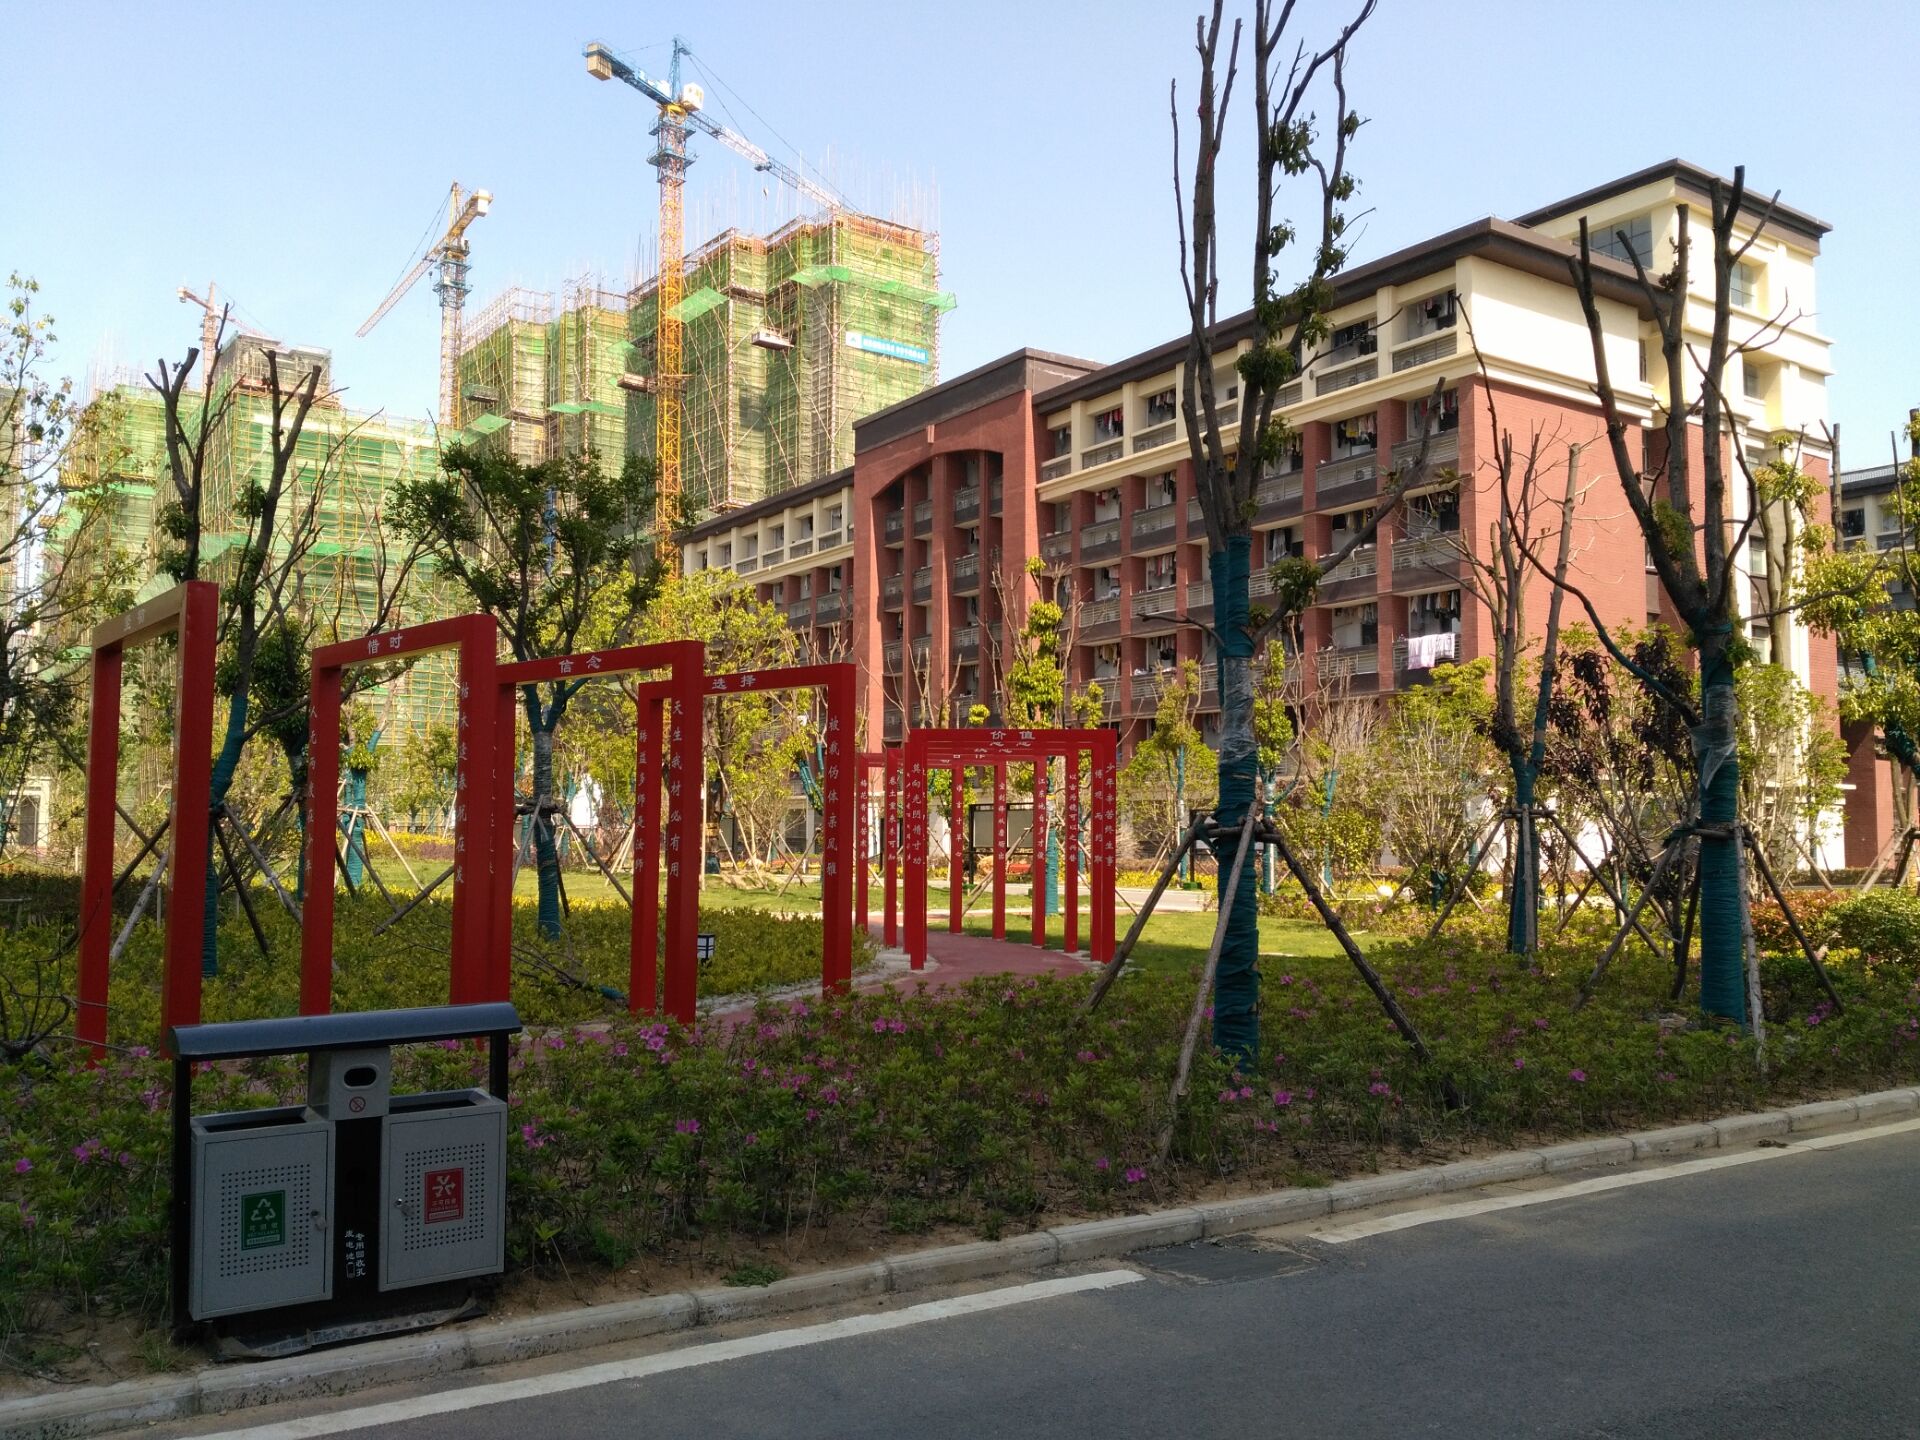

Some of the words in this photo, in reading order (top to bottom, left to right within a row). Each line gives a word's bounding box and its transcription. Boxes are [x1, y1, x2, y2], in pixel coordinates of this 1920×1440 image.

[367, 633, 403, 655] 惜时
[558, 654, 602, 674] 信念
[711, 674, 757, 691] 选择
[990, 730, 1036, 740] 价值
[669, 700, 684, 878] 天生我材必有用
